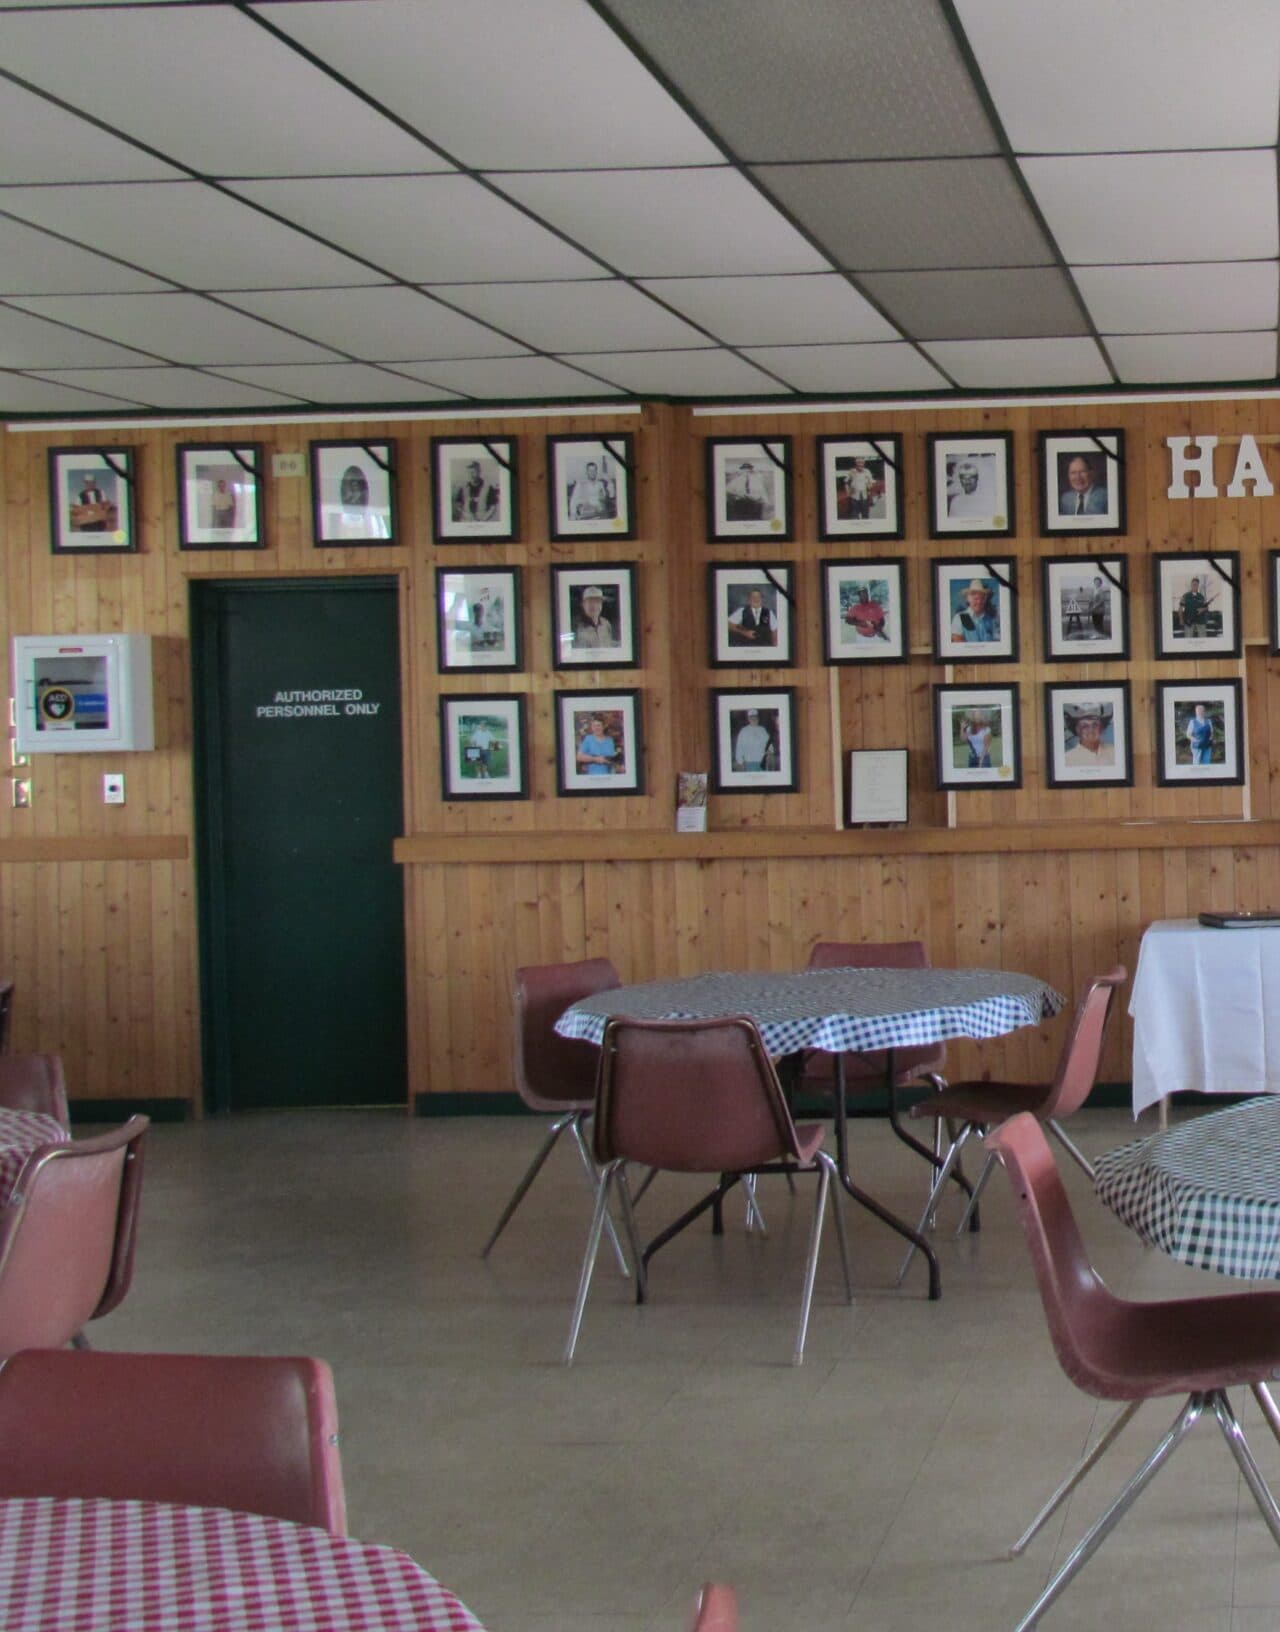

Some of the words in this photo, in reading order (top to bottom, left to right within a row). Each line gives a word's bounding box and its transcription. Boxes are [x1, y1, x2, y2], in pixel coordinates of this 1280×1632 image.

[275, 689, 362, 702] AUTHORIZED
[257, 704, 340, 717] PERSONNEL
[345, 703, 379, 715] ONLY
